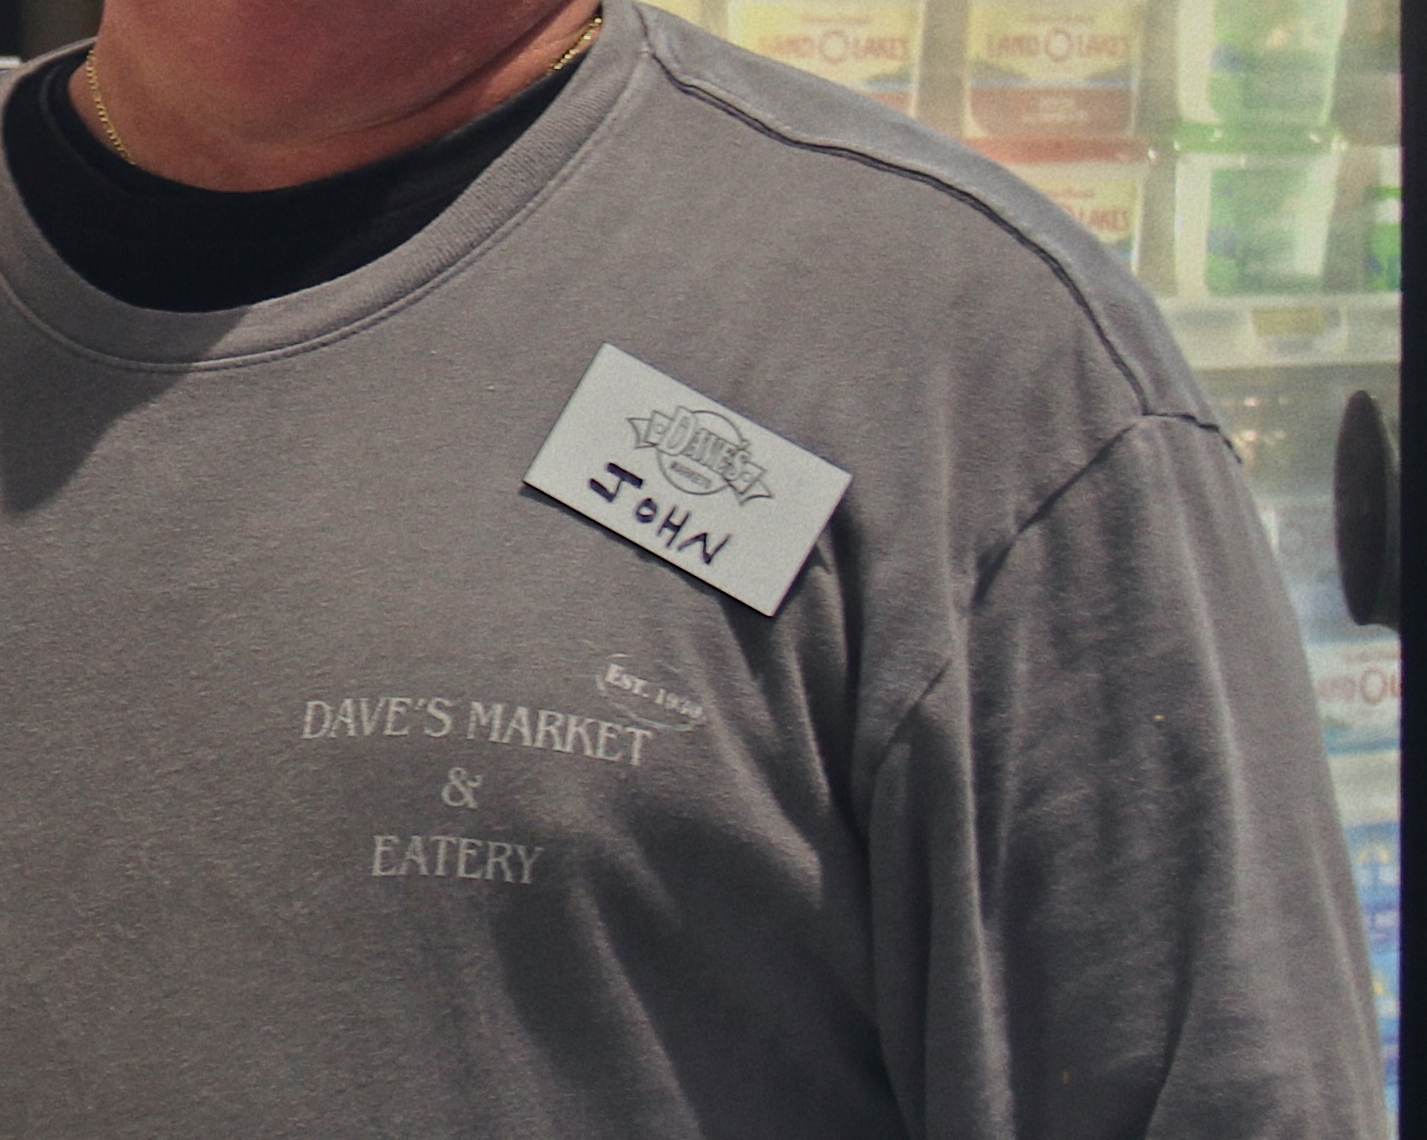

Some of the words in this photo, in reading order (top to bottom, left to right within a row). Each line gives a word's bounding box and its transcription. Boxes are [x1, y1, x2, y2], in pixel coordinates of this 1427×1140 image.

[588, 461, 733, 567] JOHN
[299, 695, 459, 741] DAVE'S
[466, 700, 656, 767] MARKET
[440, 766, 484, 809] &
[371, 833, 545, 886] EATERY
